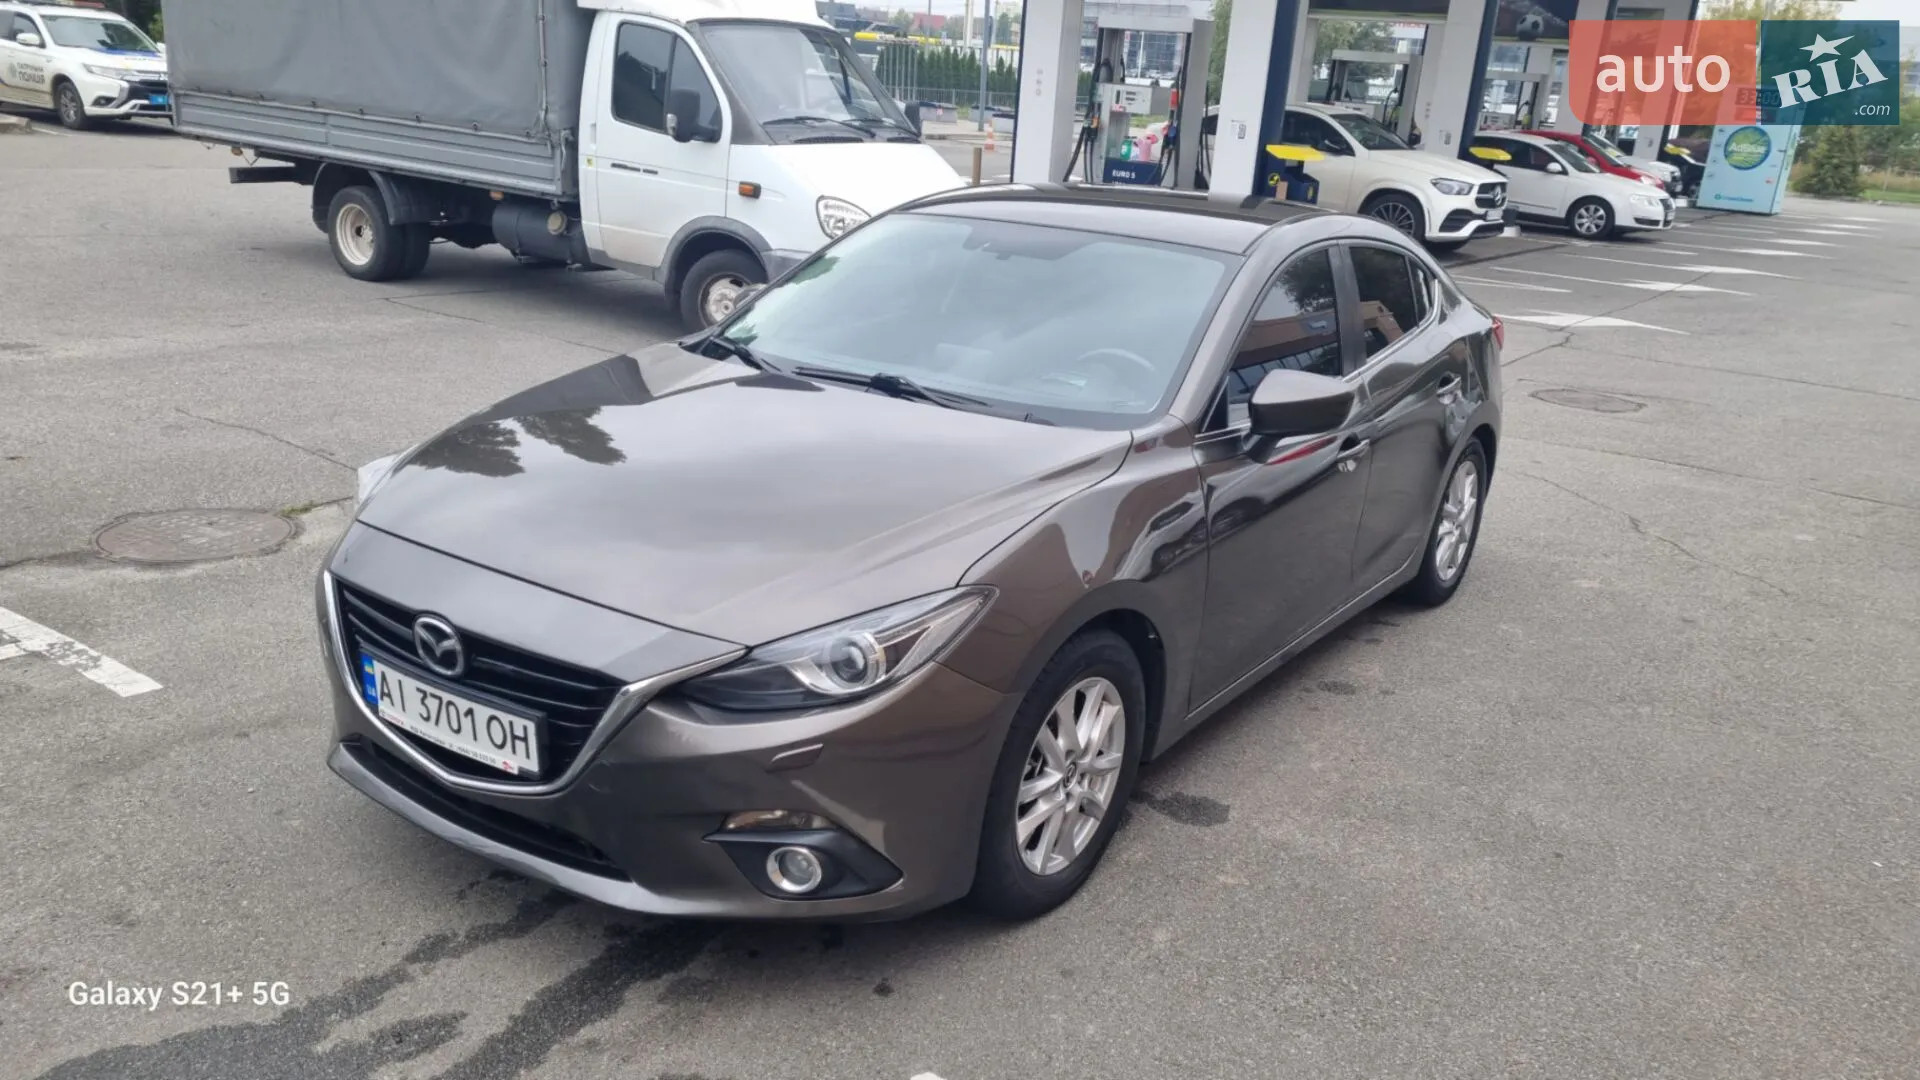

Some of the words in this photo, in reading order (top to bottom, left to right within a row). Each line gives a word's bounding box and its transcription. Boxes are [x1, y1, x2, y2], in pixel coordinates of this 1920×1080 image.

[1112, 169, 1131, 178] EURO
[380, 670, 406, 712] AI
[416, 687, 477, 742] 3701
[486, 714, 531, 760] OH
